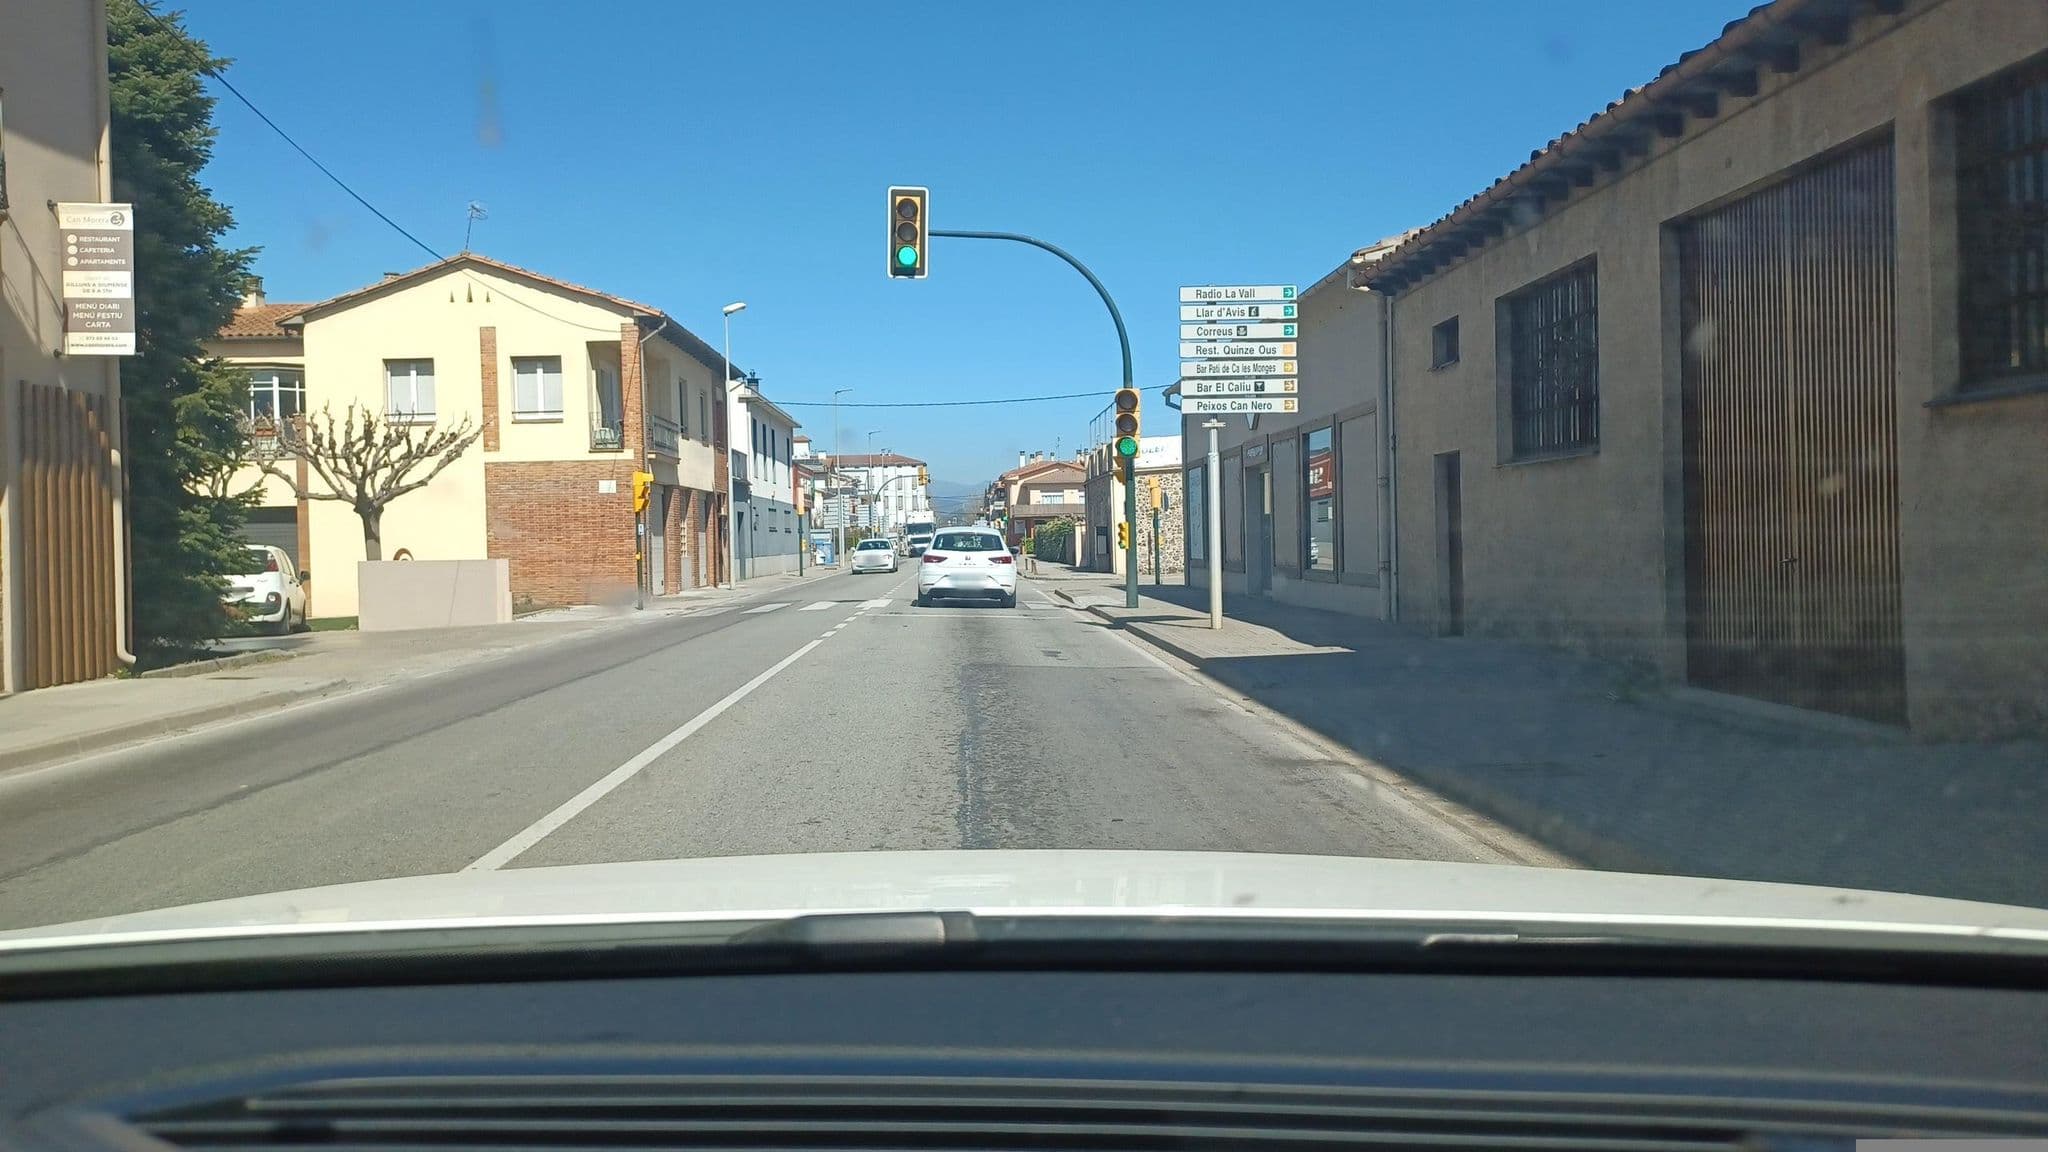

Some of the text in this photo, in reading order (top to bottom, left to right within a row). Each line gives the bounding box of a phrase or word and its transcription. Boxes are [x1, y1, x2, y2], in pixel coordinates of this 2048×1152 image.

[1195, 288, 1256, 299] Radio La Vall
[1196, 308, 1246, 318] Llar d'Avis
[1196, 326, 1233, 336] Correus
[1196, 345, 1277, 355] Rest. Quinze Ous
[1196, 364, 1207, 374] Bar
[1222, 364, 1230, 374] de
[1232, 364, 1240, 373] Ca
[1242, 364, 1252, 373] les
[1252, 364, 1276, 374] Monges
[1196, 382, 1252, 392] Bar El Caliu
[1196, 401, 1272, 411] Peixos Can Nero
